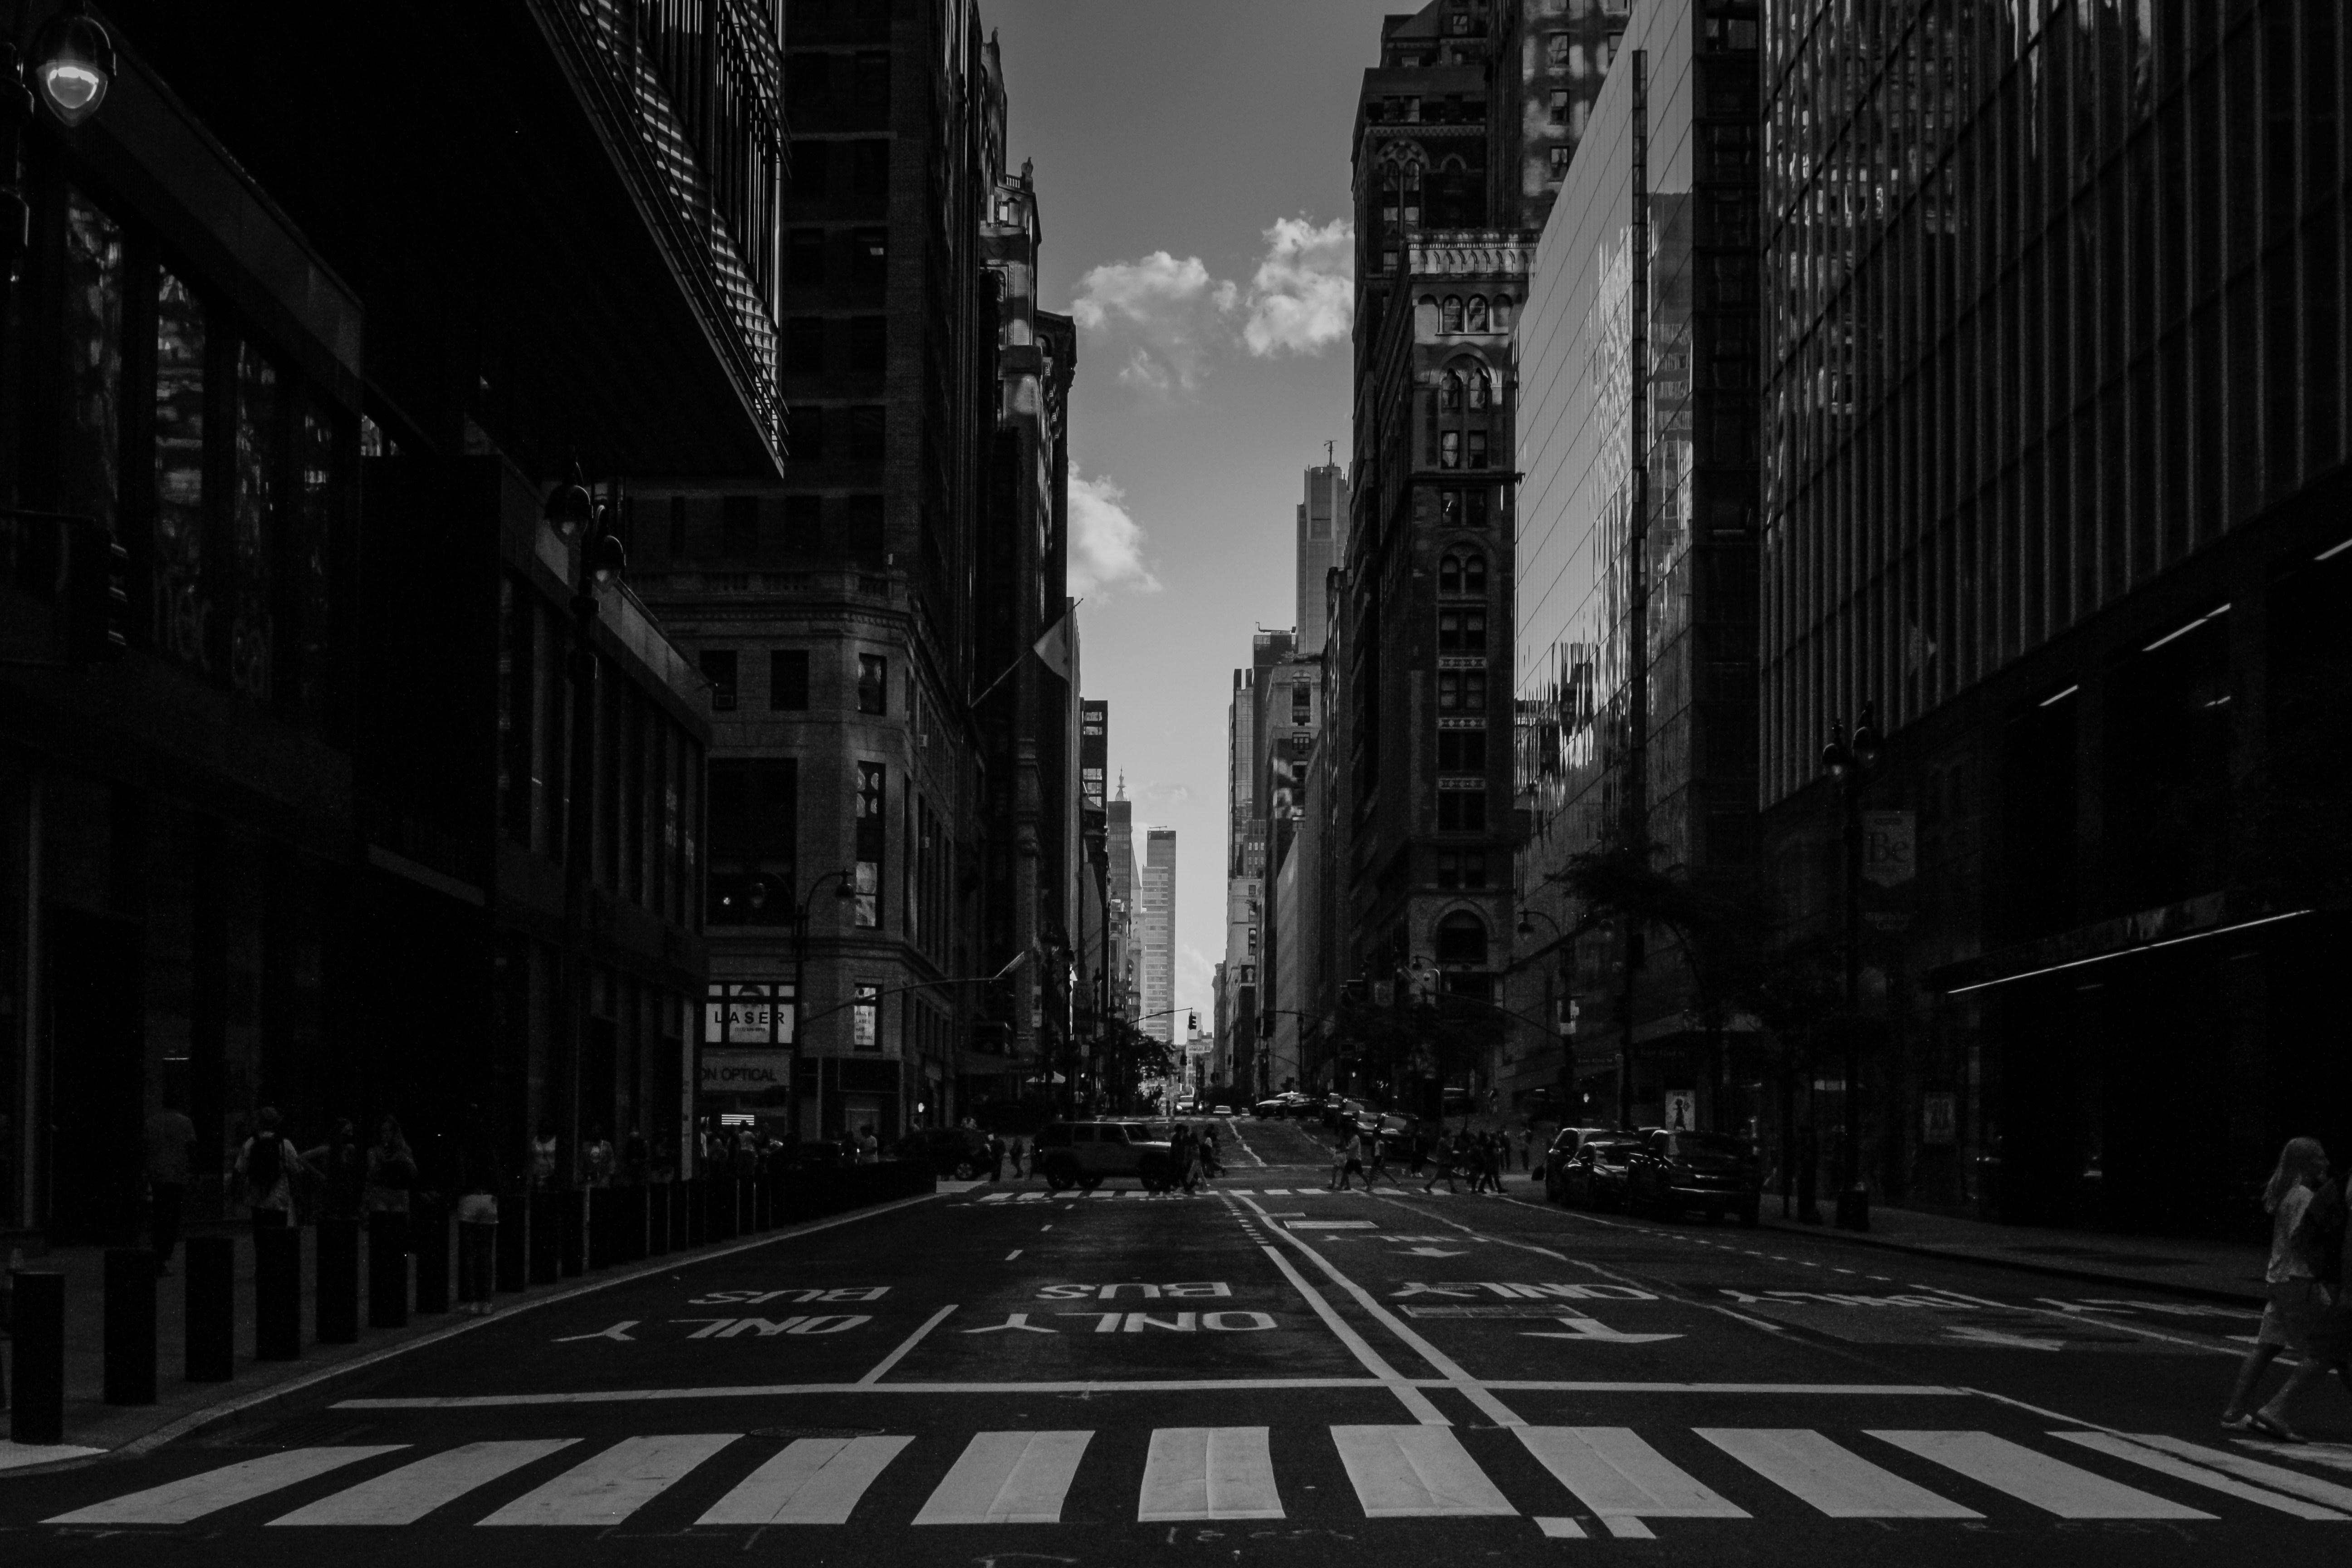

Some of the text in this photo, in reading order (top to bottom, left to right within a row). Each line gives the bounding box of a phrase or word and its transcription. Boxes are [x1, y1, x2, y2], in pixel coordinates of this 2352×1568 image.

[1865, 832, 1909, 862] Be
[715, 1011, 784, 1024] LASER
[721, 1067, 777, 1081] OPTICAL
[687, 1286, 892, 1305] BUS
[1034, 1282, 1233, 1300] BUS
[1389, 1282, 1660, 1300] ONLY
[1718, 1289, 1981, 1309] ONLY
[550, 1314, 874, 1343] ONLY
[960, 1311, 1279, 1333] ONLY
